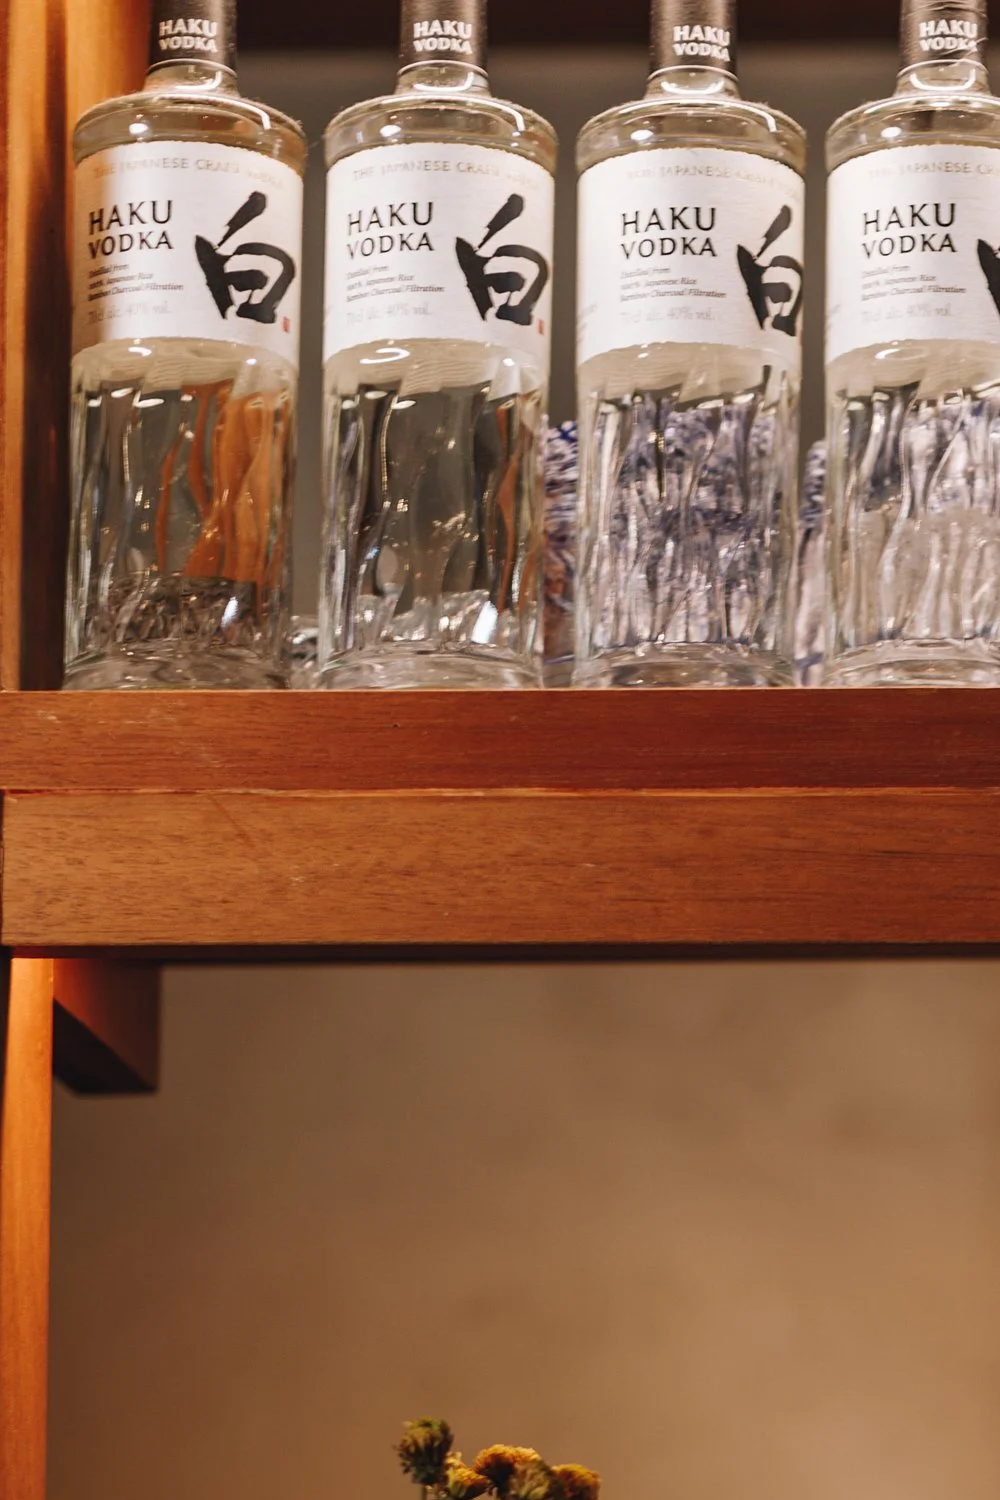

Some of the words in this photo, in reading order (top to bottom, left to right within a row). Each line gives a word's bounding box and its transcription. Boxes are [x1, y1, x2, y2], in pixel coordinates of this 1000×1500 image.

[159, 18, 218, 37] HAKU
[413, 20, 472, 39] HAKU
[673, 25, 730, 46] HAKU
[919, 19, 978, 38] HAKU
[159, 36, 218, 53] VODKA
[413, 38, 472, 54] VODKA
[672, 43, 731, 62] VODKA
[919, 37, 978, 52] VODKA
[88, 200, 173, 235] HAKU
[347, 201, 434, 236] HAKU
[621, 206, 716, 236] HAKU
[862, 203, 956, 236] HAKU
[87, 230, 173, 259] VODKA
[346, 232, 434, 259] VODKA
[620, 237, 717, 259] VODKA
[862, 233, 957, 259] VODKA
